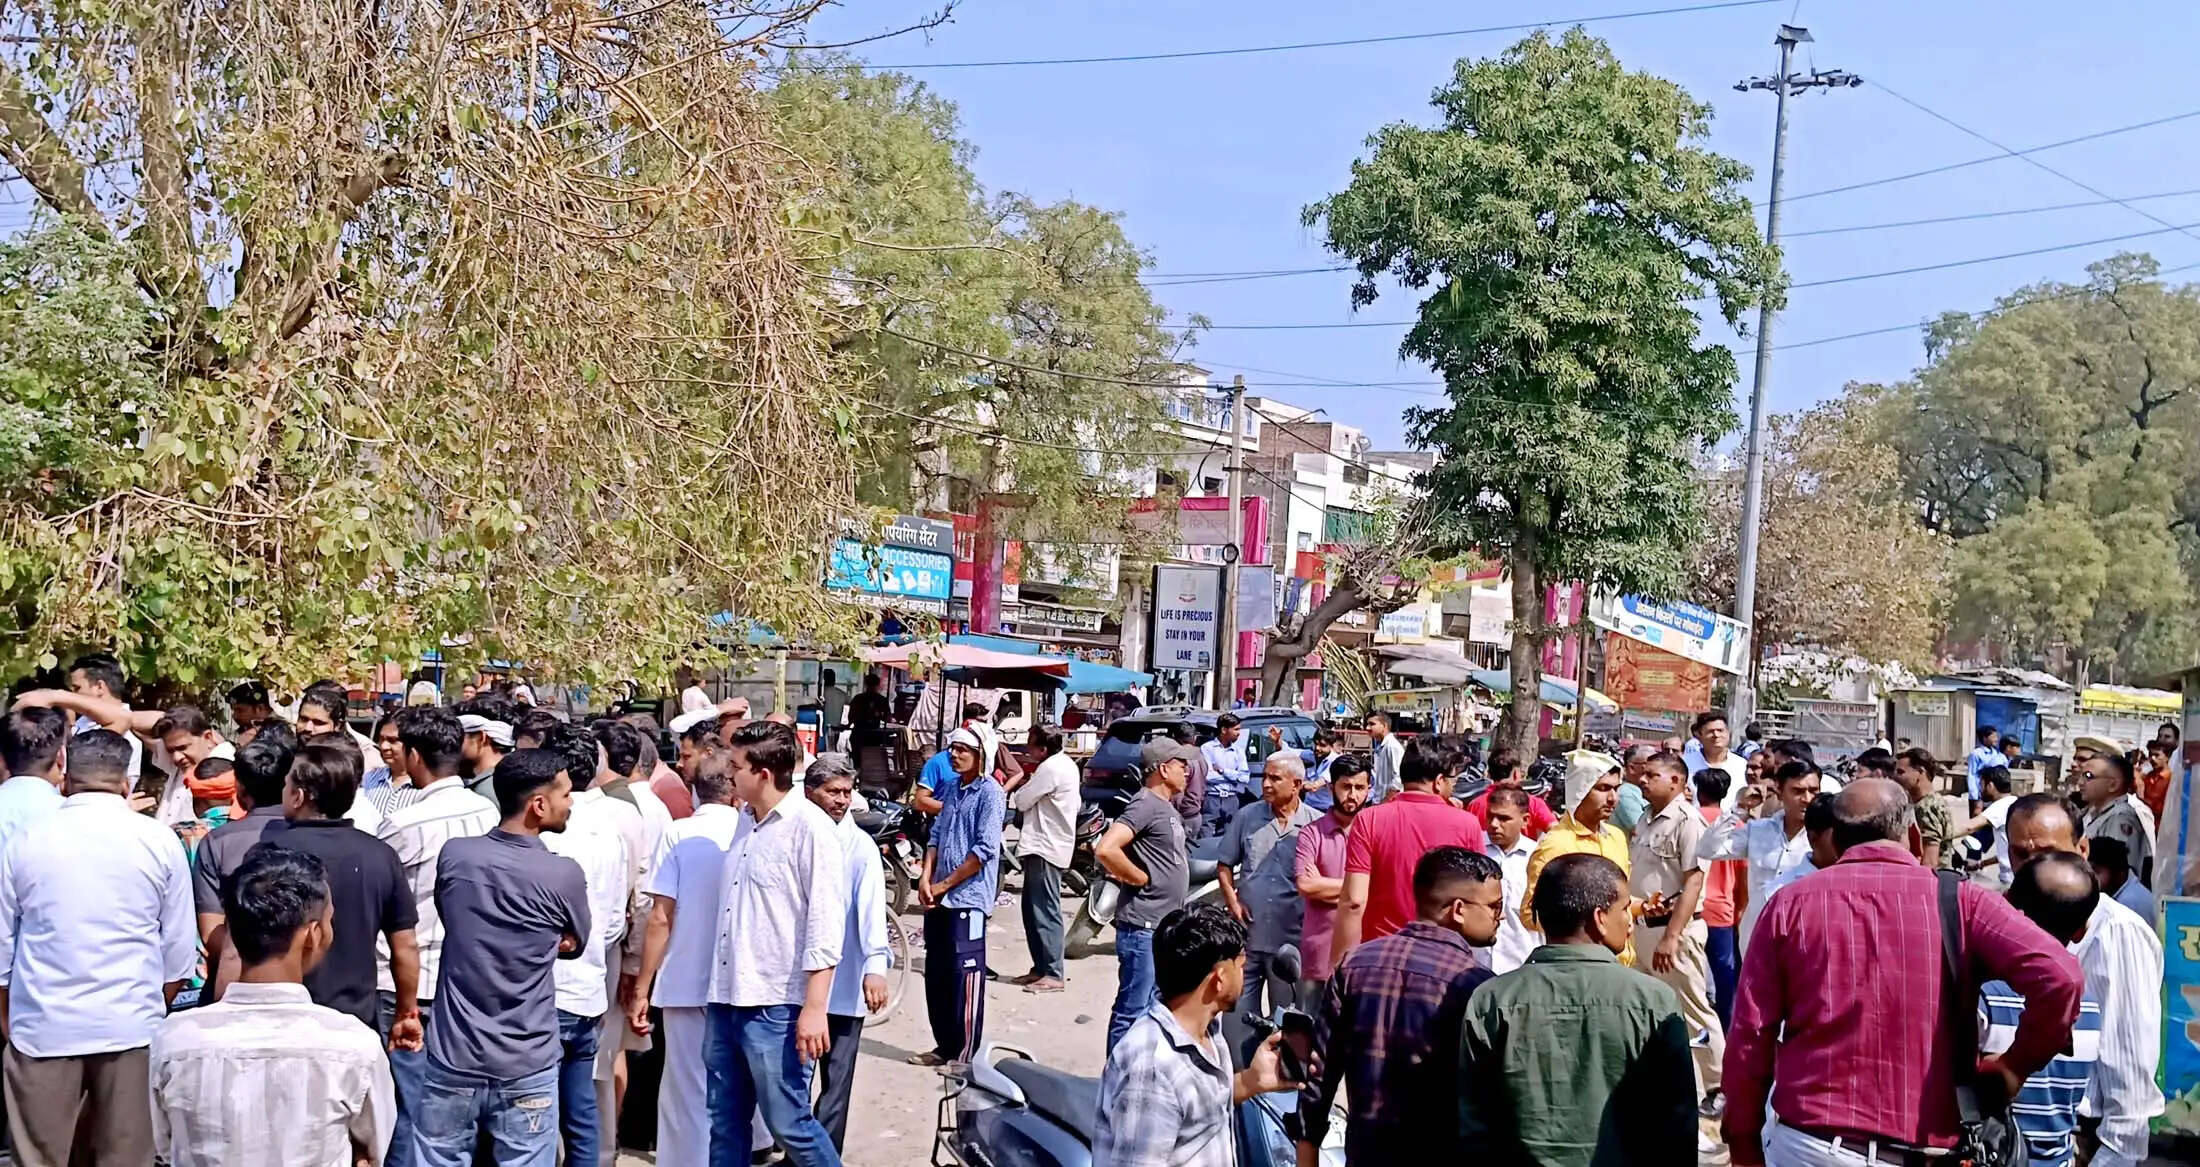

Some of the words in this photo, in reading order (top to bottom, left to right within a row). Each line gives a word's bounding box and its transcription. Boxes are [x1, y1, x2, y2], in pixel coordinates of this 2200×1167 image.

[881, 547, 952, 570] ACCESSORIES
[1160, 609, 1174, 620] LIFE
[1175, 610, 1182, 621] IS
[1182, 610, 1213, 622] PRECIOUS
[1165, 629, 1179, 640] STAY
[1181, 630, 1188, 641] IN
[1189, 630, 1206, 641] YOUR
[1176, 649, 1192, 661] LANE
